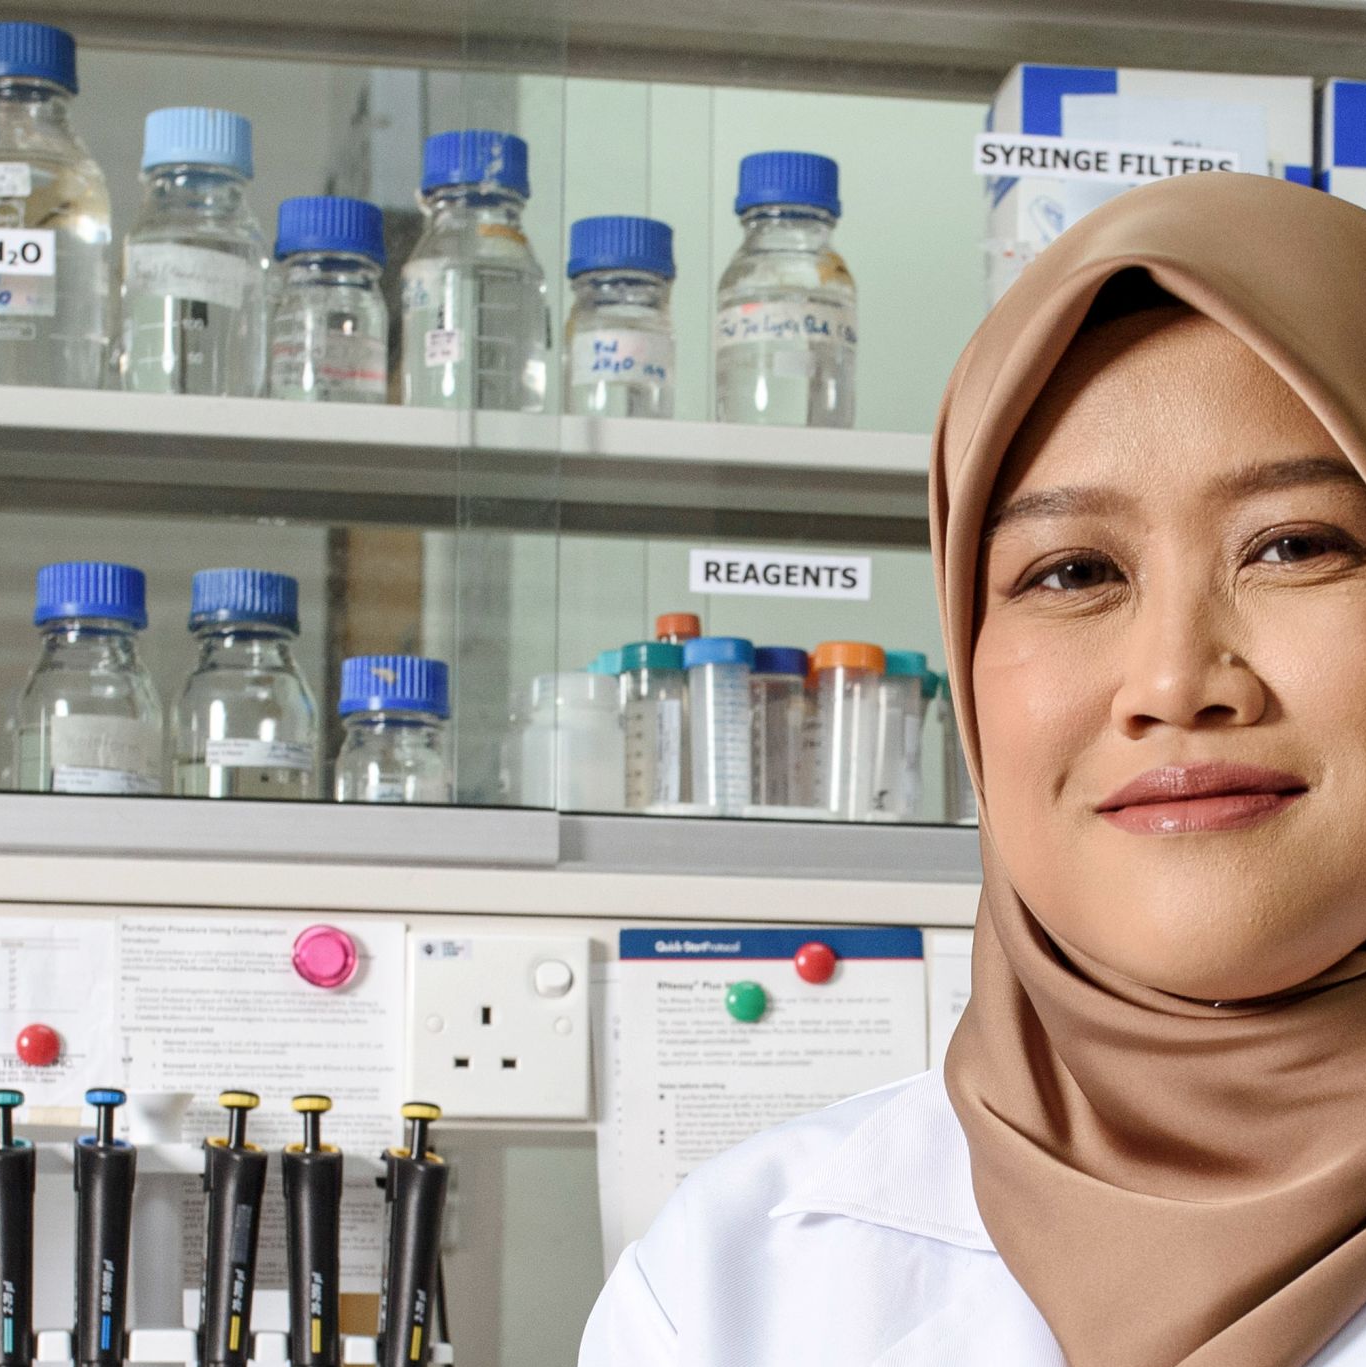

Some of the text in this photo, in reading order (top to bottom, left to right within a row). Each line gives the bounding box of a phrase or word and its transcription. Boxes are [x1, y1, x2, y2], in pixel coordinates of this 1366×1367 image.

[980, 142, 1234, 178] SYRINGE FILTERS
[703, 560, 859, 590] REAGENTS
